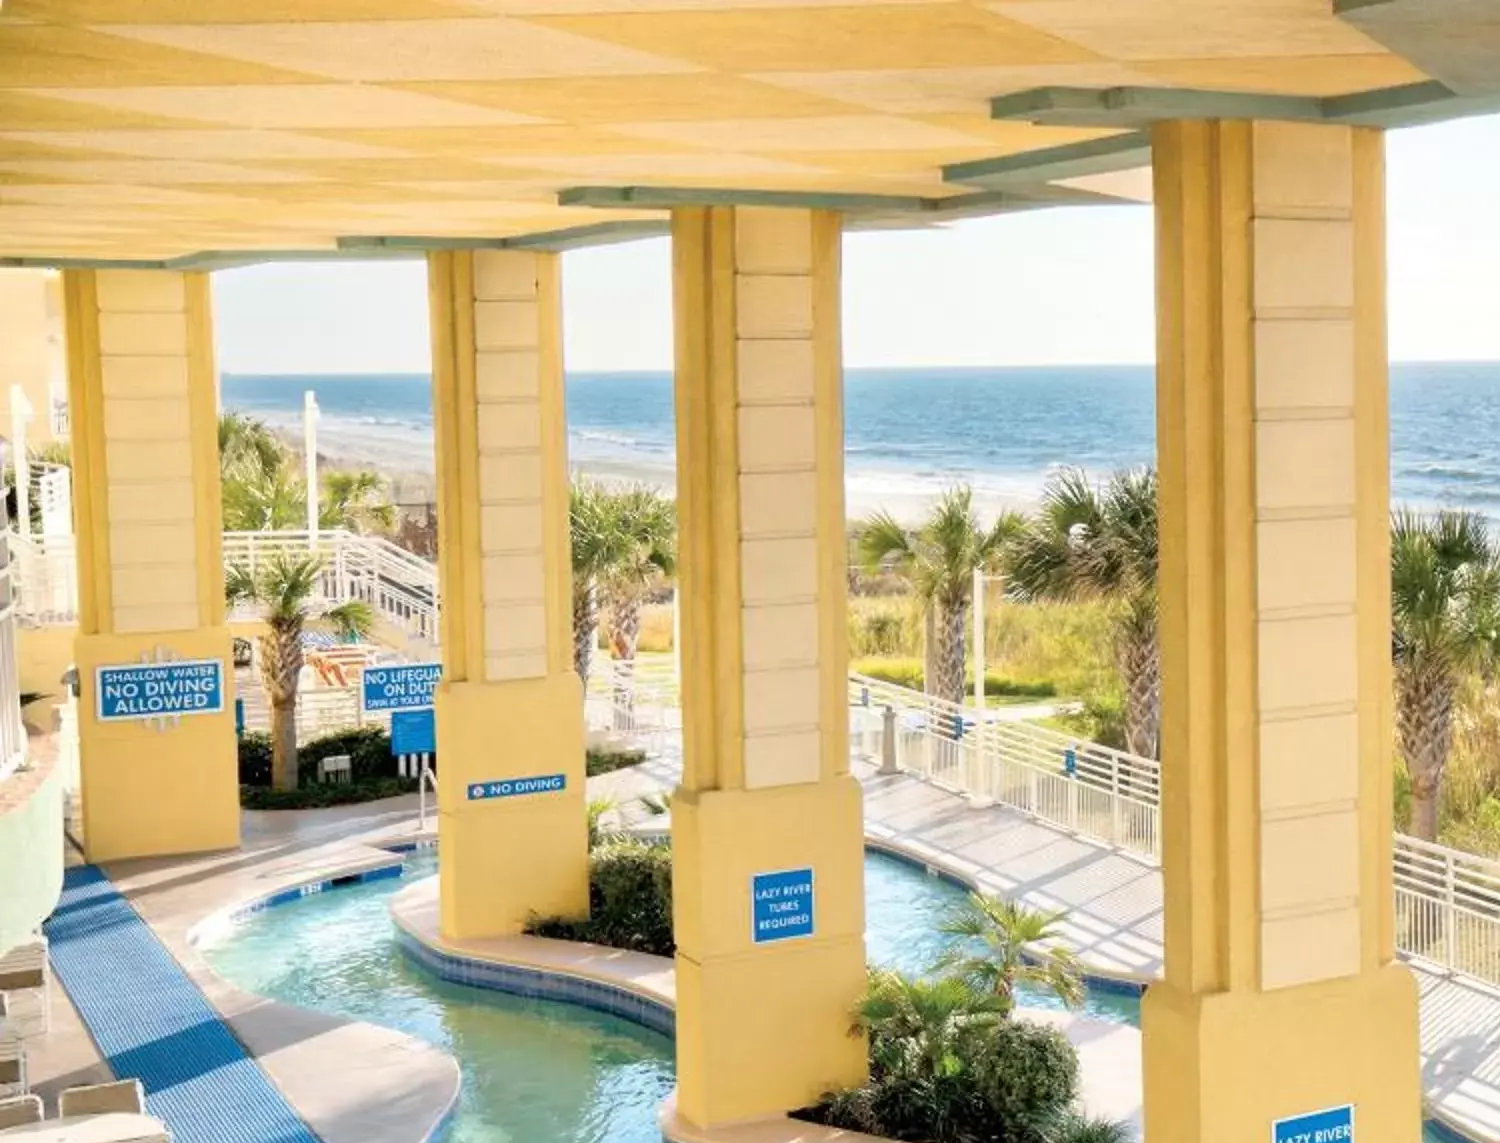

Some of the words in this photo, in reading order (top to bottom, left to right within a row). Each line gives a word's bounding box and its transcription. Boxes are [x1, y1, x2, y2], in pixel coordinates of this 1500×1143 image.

[104, 670, 169, 683] SHALLOW
[171, 666, 215, 678] WATER
[365, 671, 387, 685] NO
[390, 667, 442, 683] LIFEGUA
[105, 683, 139, 699] NO
[145, 678, 215, 696] DIVING
[383, 683, 405, 697] ON
[409, 682, 434, 695] DUT
[115, 693, 208, 713] ALLOWED
[490, 783, 511, 795] NO
[515, 777, 561, 793] DIVING
[1315, 1124, 1352, 1143] RIVER
